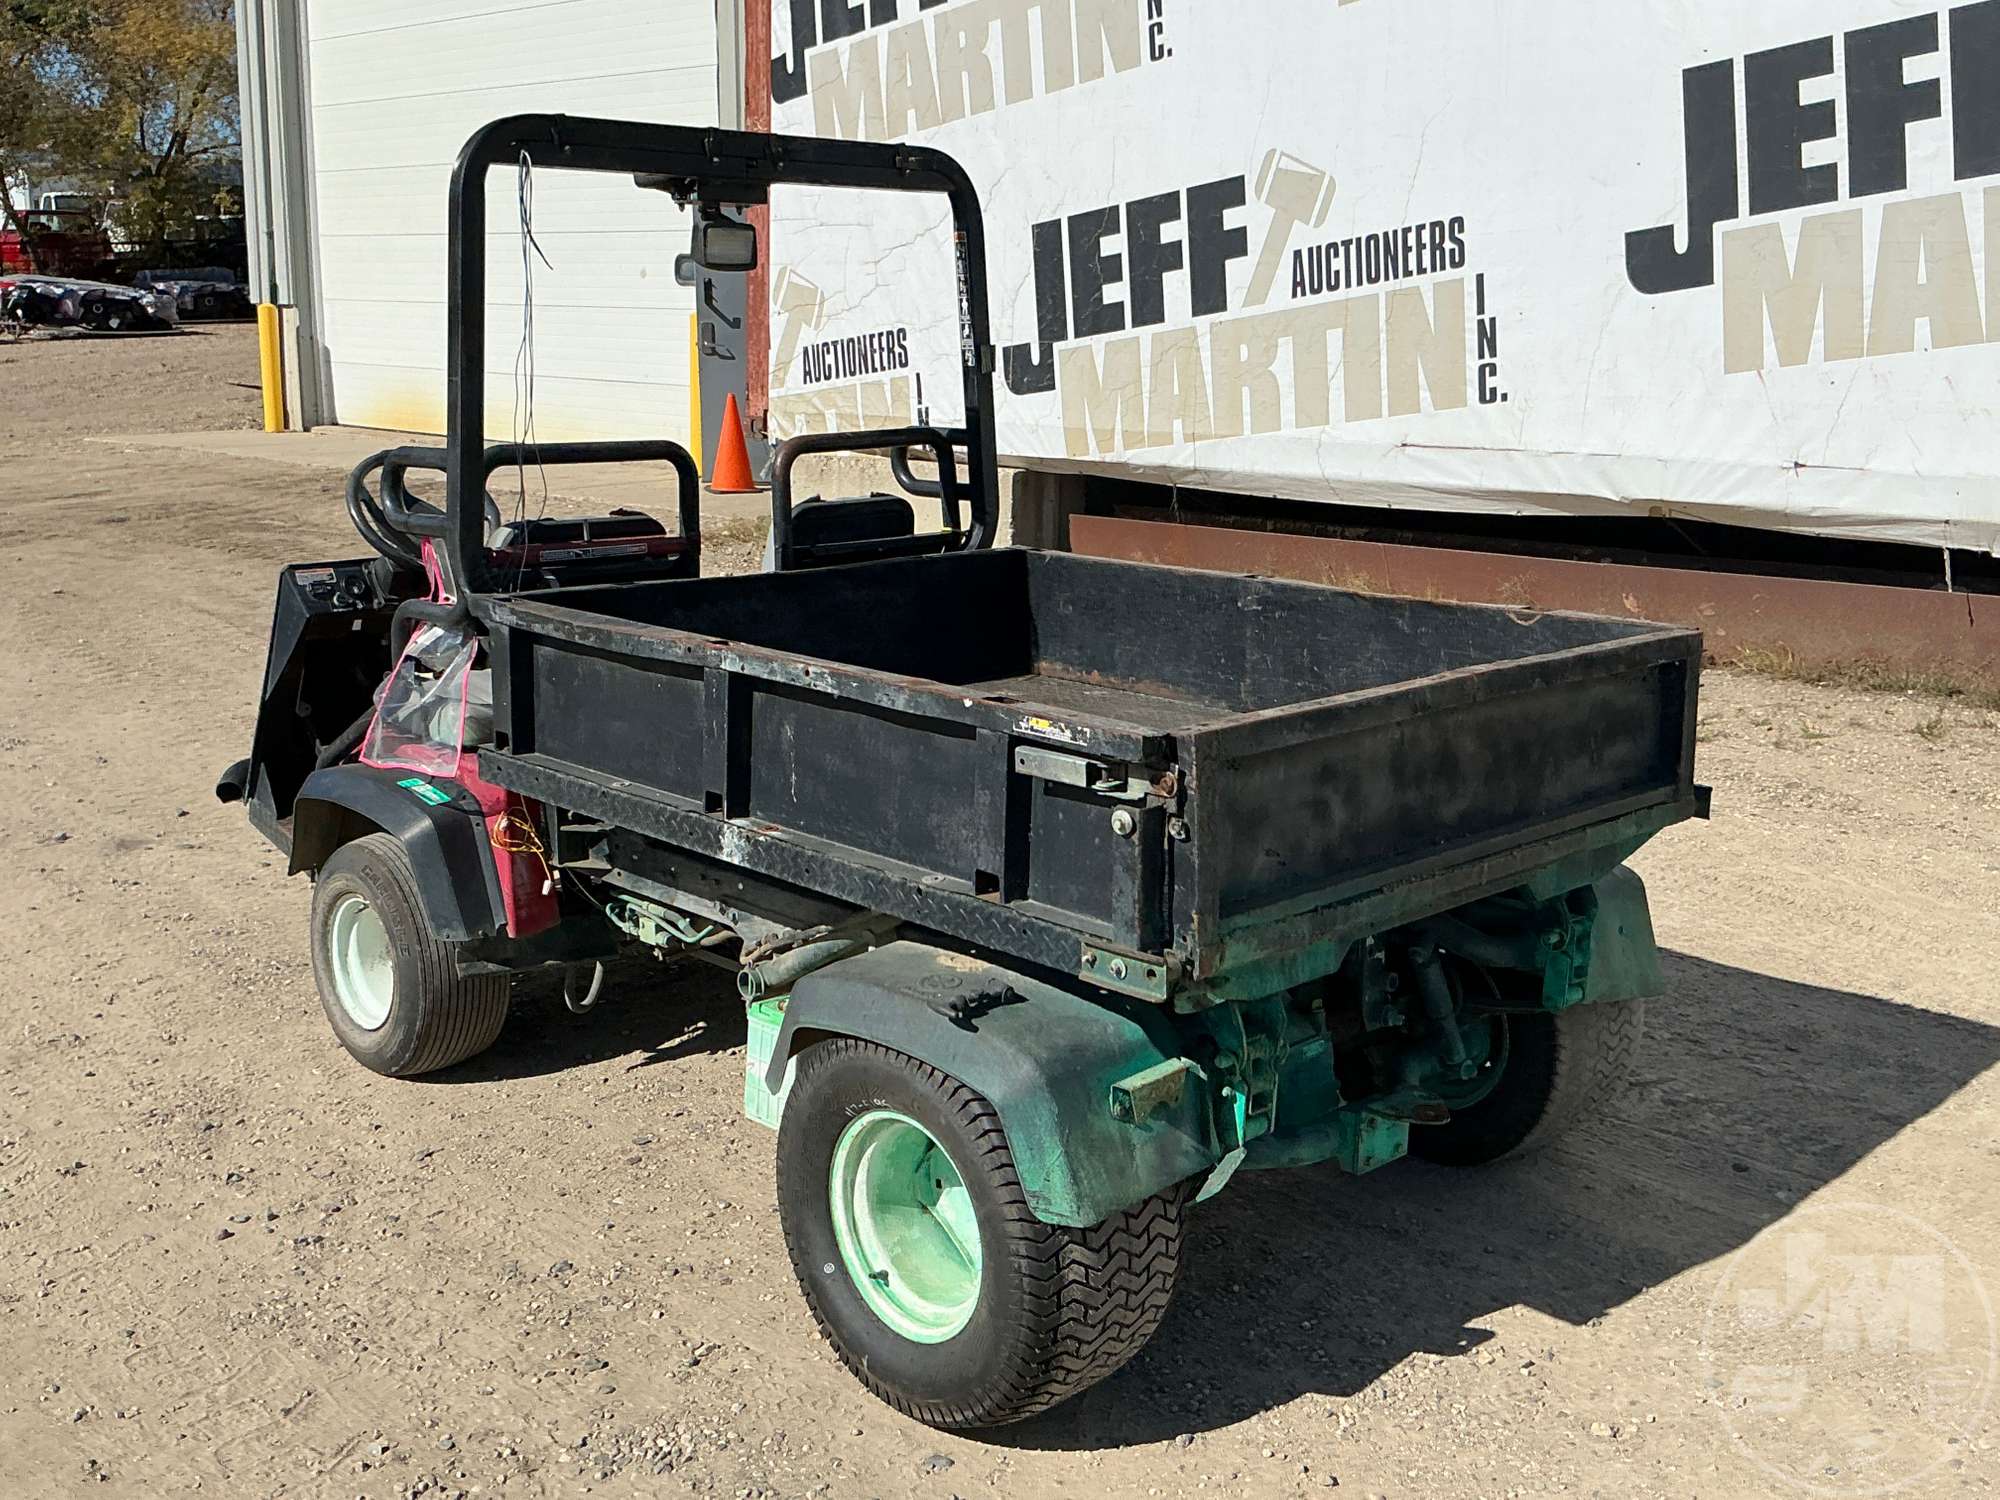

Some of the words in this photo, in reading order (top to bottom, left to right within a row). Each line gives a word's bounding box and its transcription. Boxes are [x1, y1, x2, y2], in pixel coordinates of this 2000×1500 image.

[809, 0, 1141, 141] MARTIN
[1003, 174, 1248, 396] JEFF
[1291, 216, 1465, 300] AUCTIONEERS
[1721, 186, 2000, 375] MA
[802, 327, 909, 385] AUCTIONEERS
[1059, 277, 1468, 458] MARTIN
[1475, 272, 1508, 405] INC.
